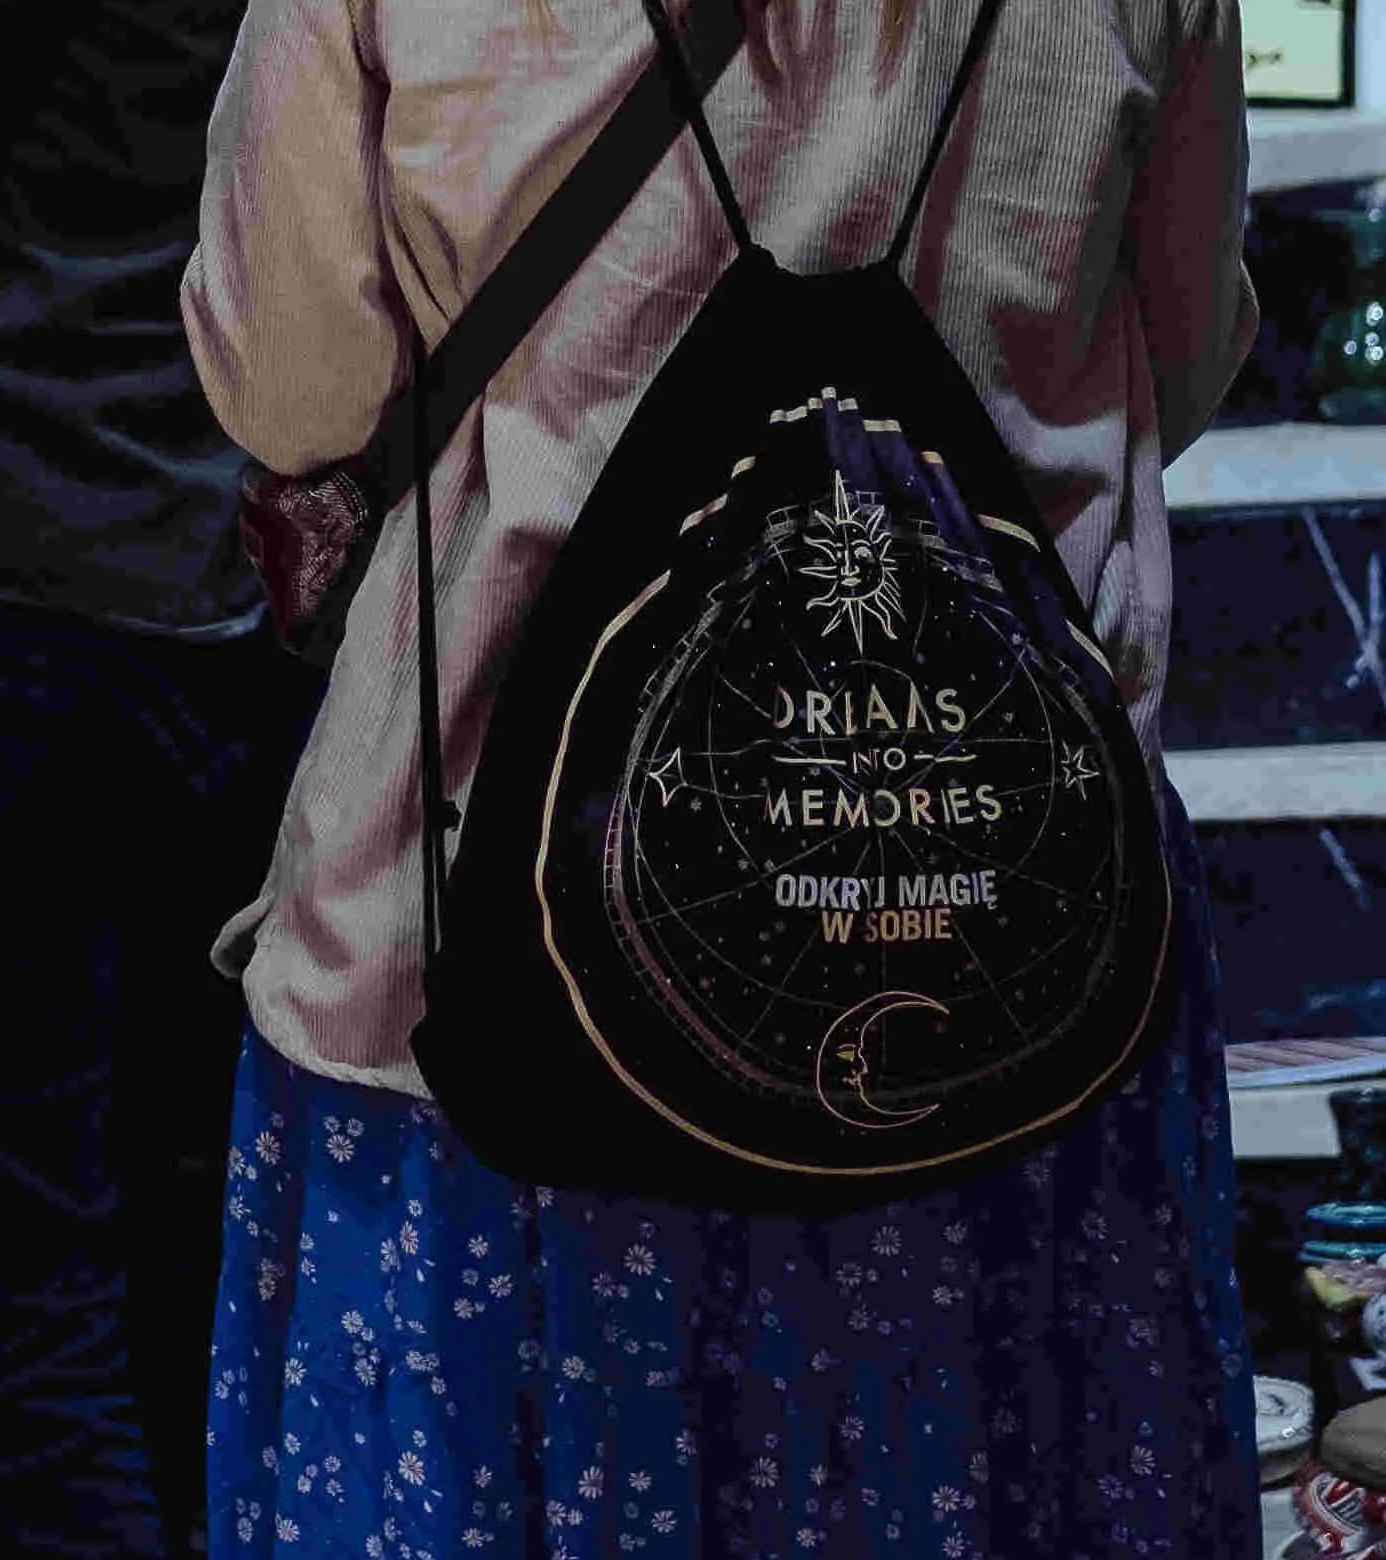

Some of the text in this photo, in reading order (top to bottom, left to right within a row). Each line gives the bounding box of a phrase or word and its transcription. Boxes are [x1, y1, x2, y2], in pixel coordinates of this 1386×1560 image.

[763, 783, 1004, 829] MEMORIES
[774, 869, 998, 912] ODKRYJ MAGIĘ
[820, 907, 954, 945] W SOBIE
